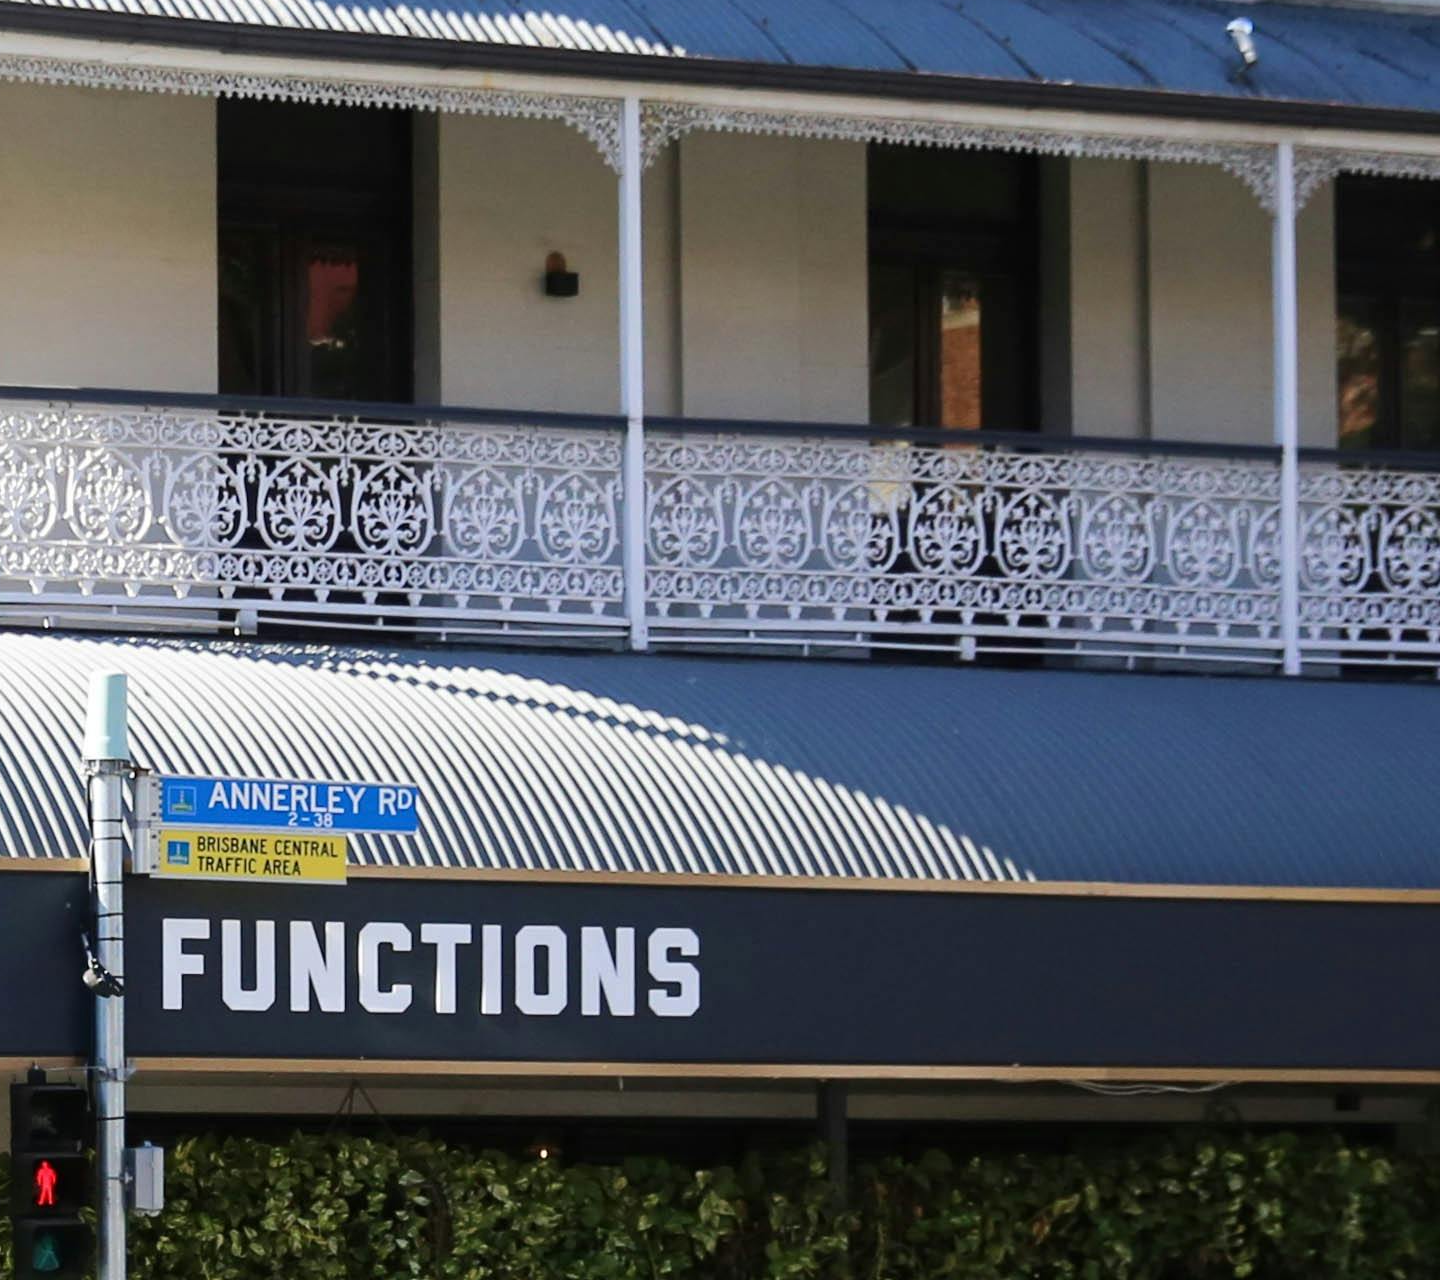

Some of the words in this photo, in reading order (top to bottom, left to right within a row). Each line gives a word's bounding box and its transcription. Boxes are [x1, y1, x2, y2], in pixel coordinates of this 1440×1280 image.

[208, 781, 366, 815] ANNERLEY
[378, 788, 413, 816] RD
[197, 836, 268, 855] BRISBANE
[274, 840, 338, 858] CENTRAL
[198, 856, 257, 875] TRAFFIC
[263, 859, 301, 875] AREA
[162, 918, 700, 1017] FUNCTIONS
